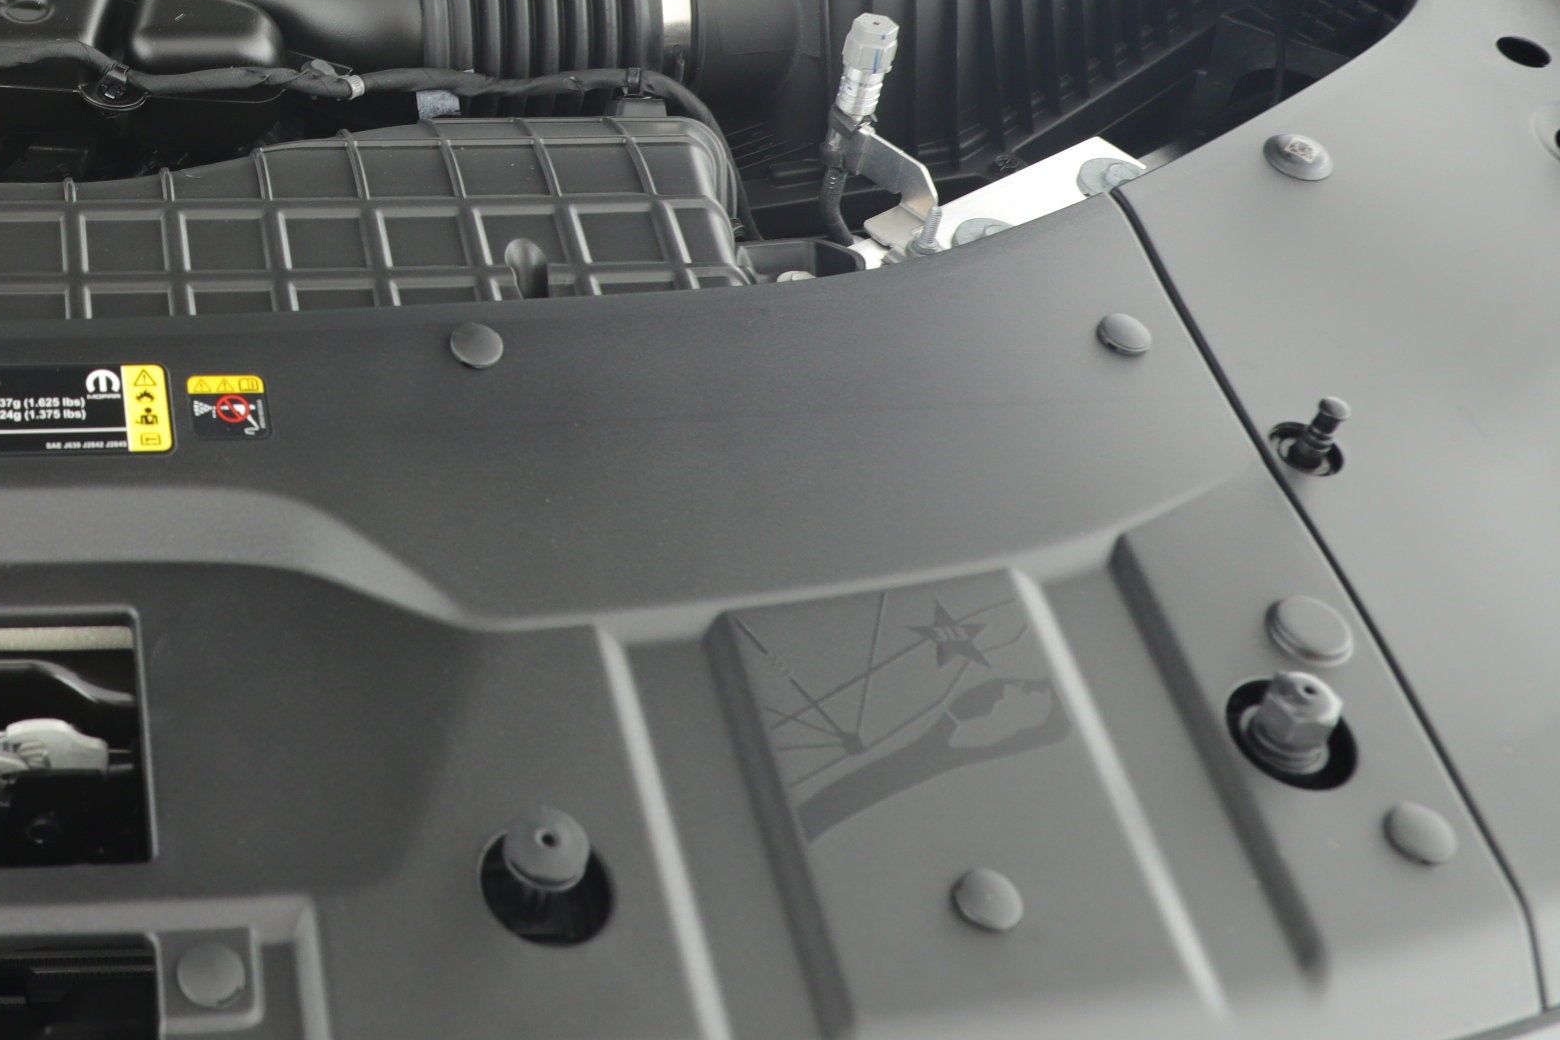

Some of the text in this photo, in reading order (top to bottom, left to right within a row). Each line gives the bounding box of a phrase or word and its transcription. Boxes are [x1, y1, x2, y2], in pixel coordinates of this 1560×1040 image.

[23, 397, 60, 409] (1.625
[62, 396, 86, 408] lbs)
[24, 409, 61, 421] (1.375
[63, 409, 87, 421] lbs)
